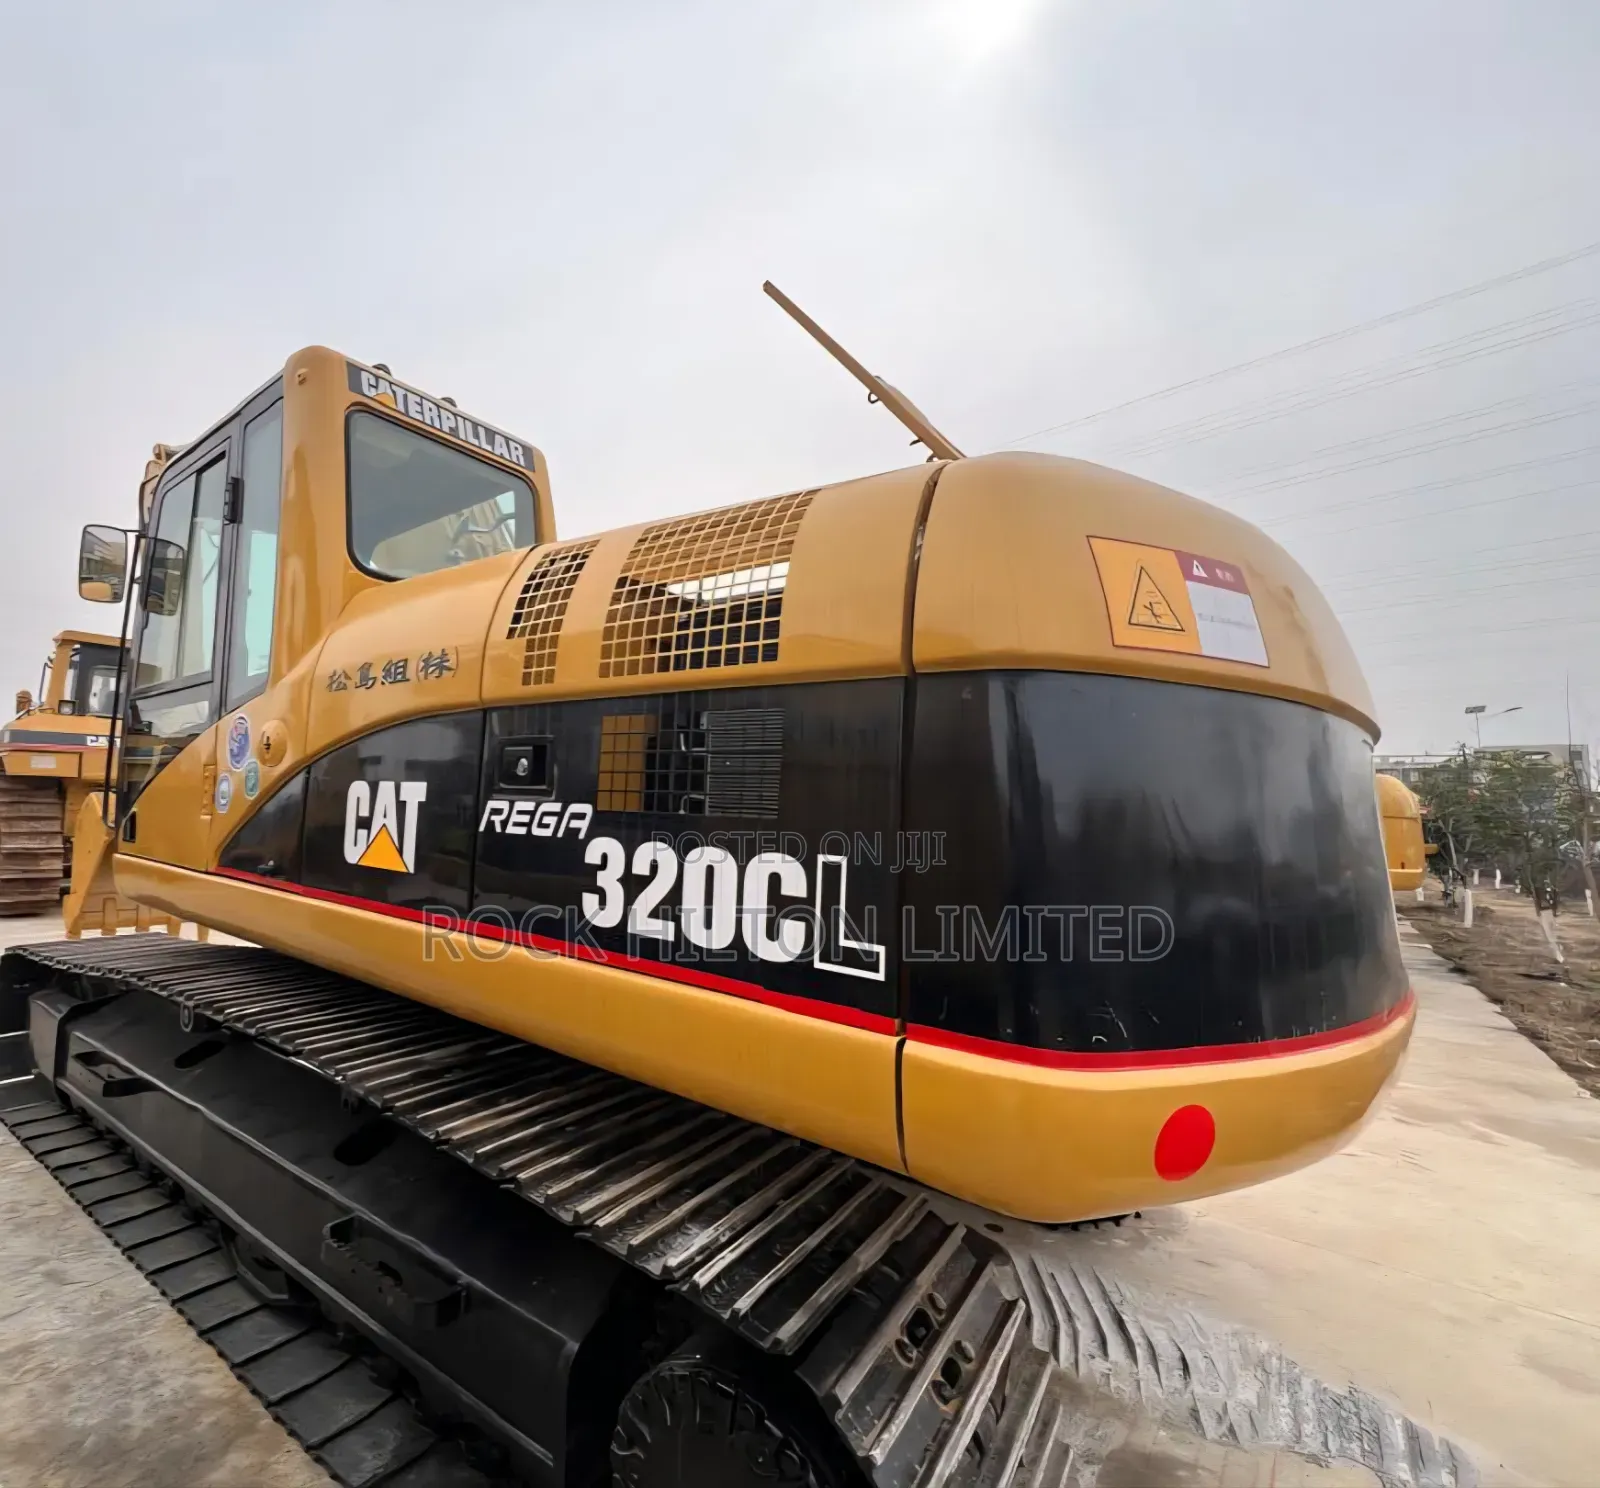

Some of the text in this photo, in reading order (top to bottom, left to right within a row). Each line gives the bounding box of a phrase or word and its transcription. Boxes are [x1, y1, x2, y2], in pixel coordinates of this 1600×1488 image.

[361, 370, 525, 467] CATERPILLAR
[343, 780, 427, 874] CAT
[478, 800, 593, 839] REGA
[581, 836, 886, 981] 320CL
